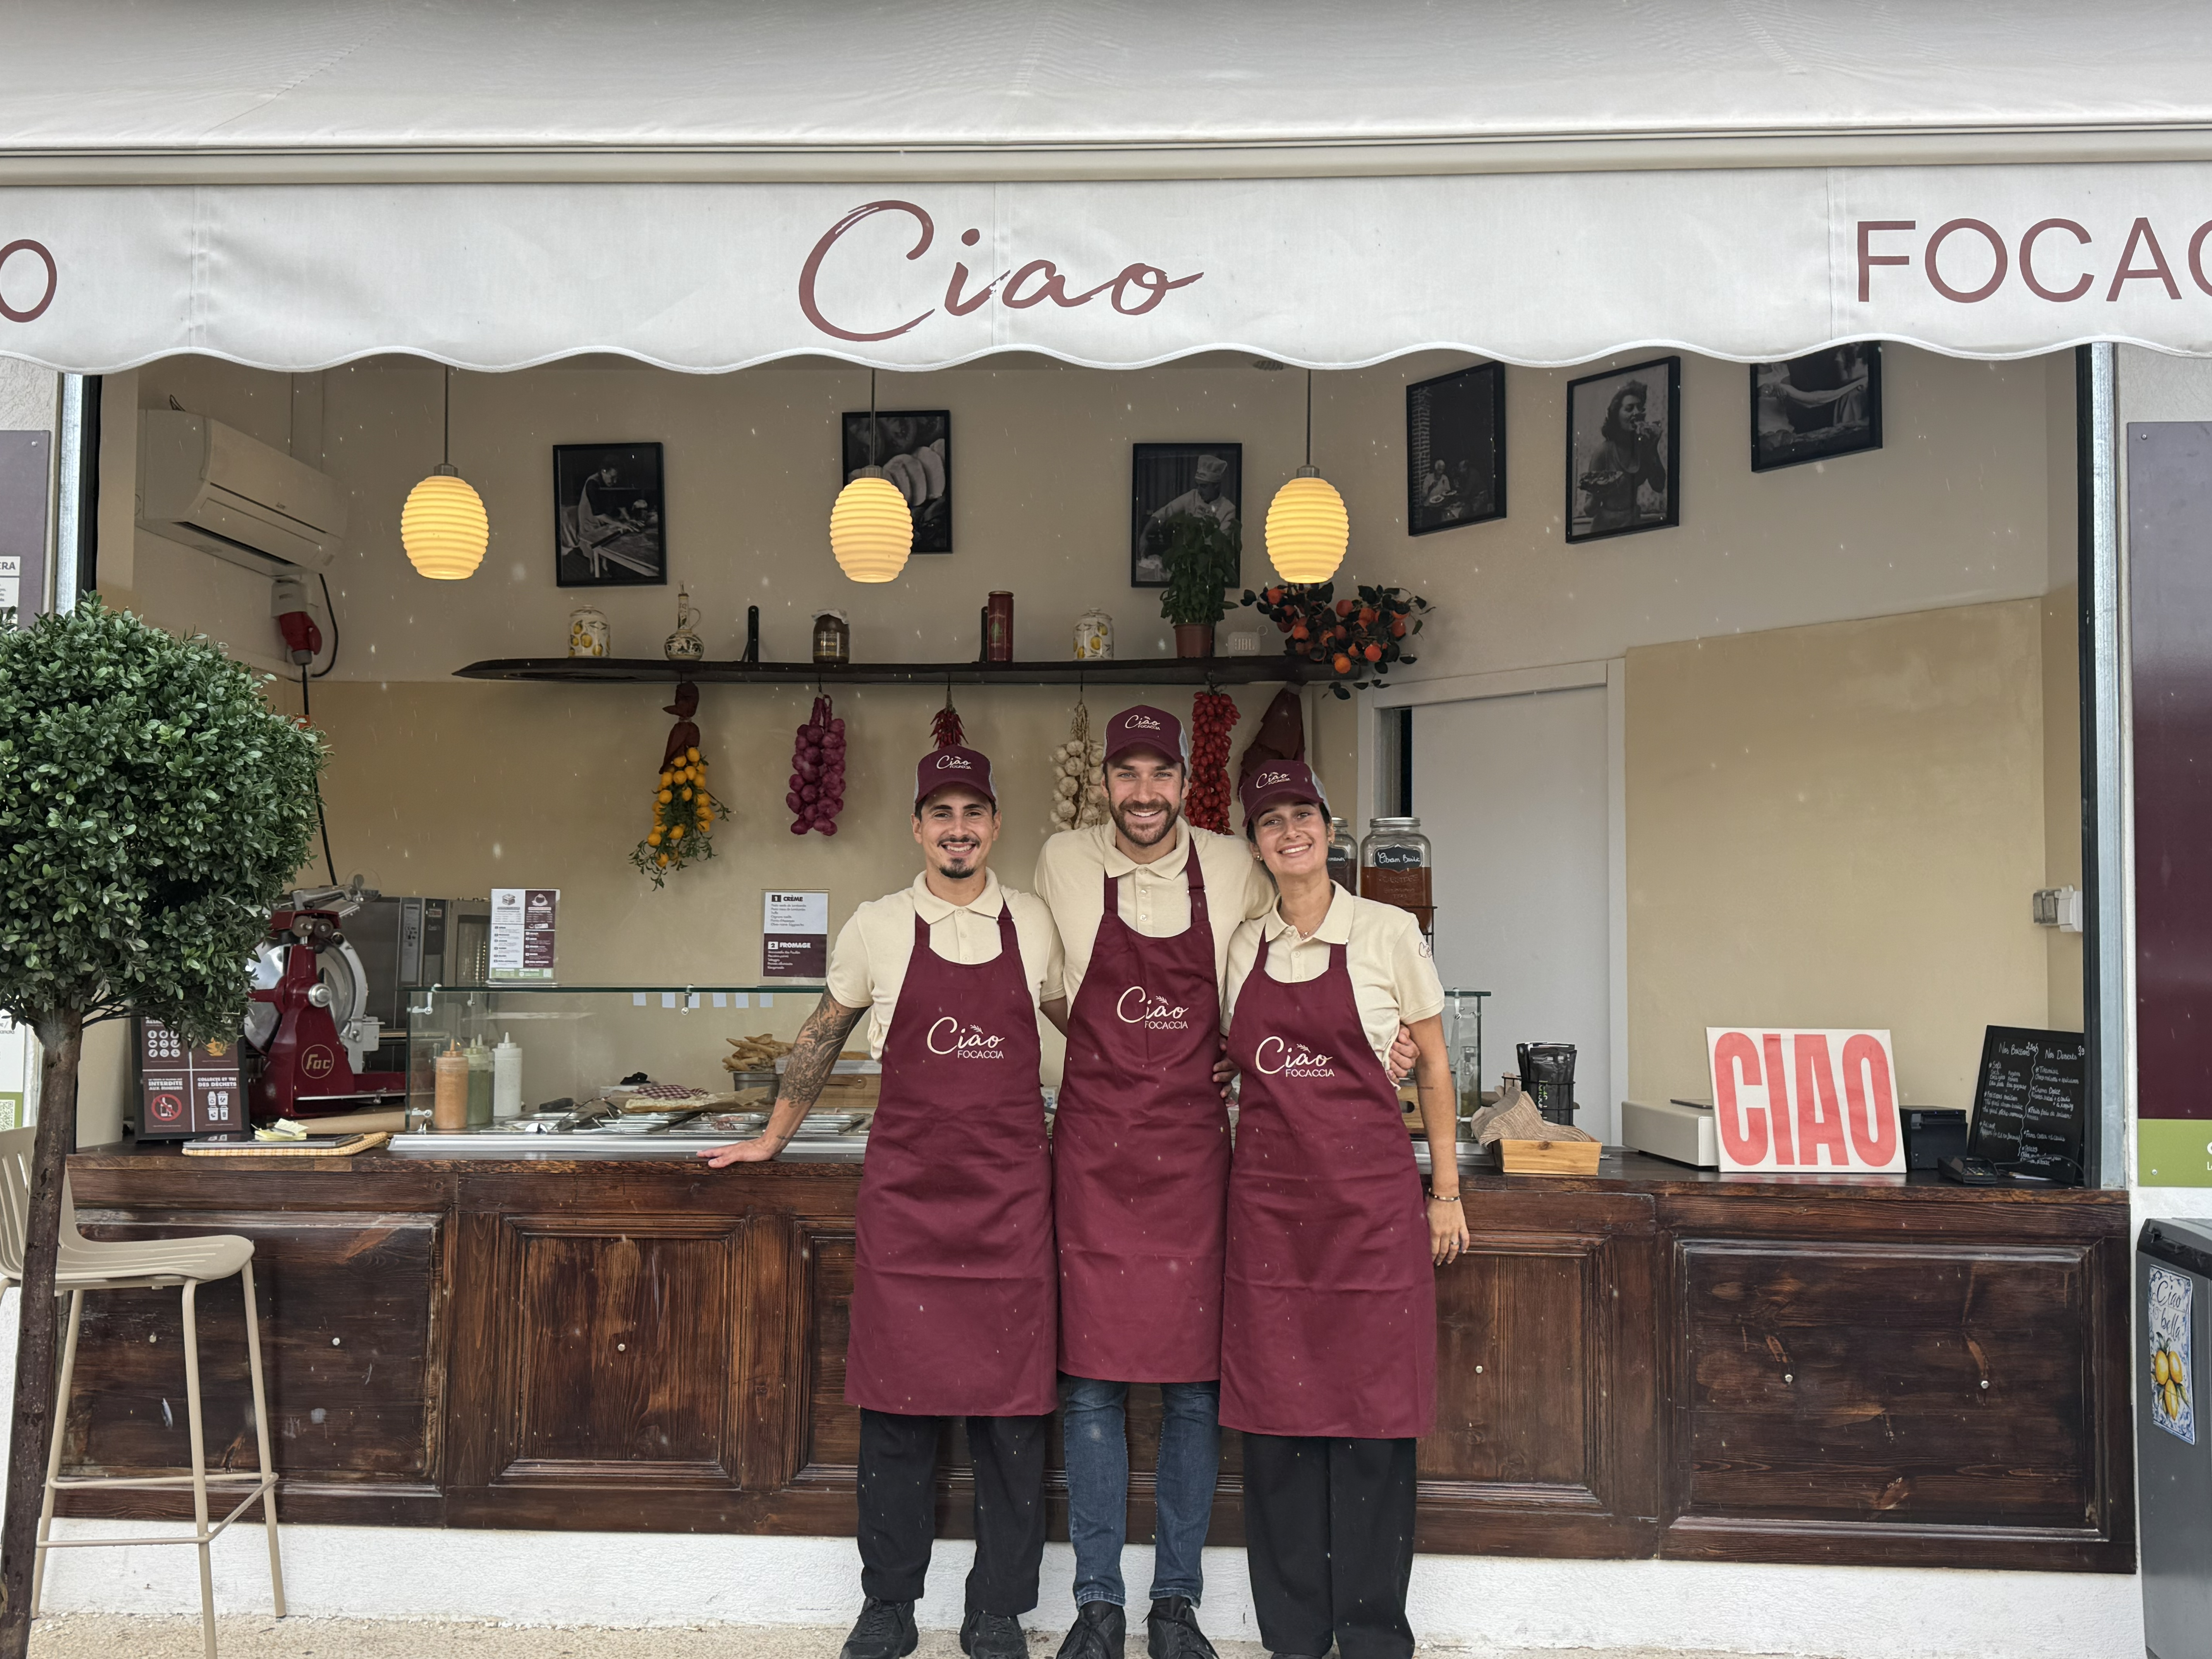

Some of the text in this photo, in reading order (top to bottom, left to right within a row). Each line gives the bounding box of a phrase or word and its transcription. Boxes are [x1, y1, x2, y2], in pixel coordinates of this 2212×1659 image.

[799, 200, 1204, 342] Ciao
[1235, 638, 1255, 650] JBL
[1144, 1020, 1188, 1029] FOCACCIA
[306, 1054, 331, 1070] Fac
[957, 1050, 1004, 1059] FOCACCIA
[1286, 1068, 1335, 1077] FOCACCIA
[1714, 1032, 1896, 1167] CIAO
[2157, 1280, 2181, 1308] Ciao
[2160, 1307, 2181, 1342] bella
